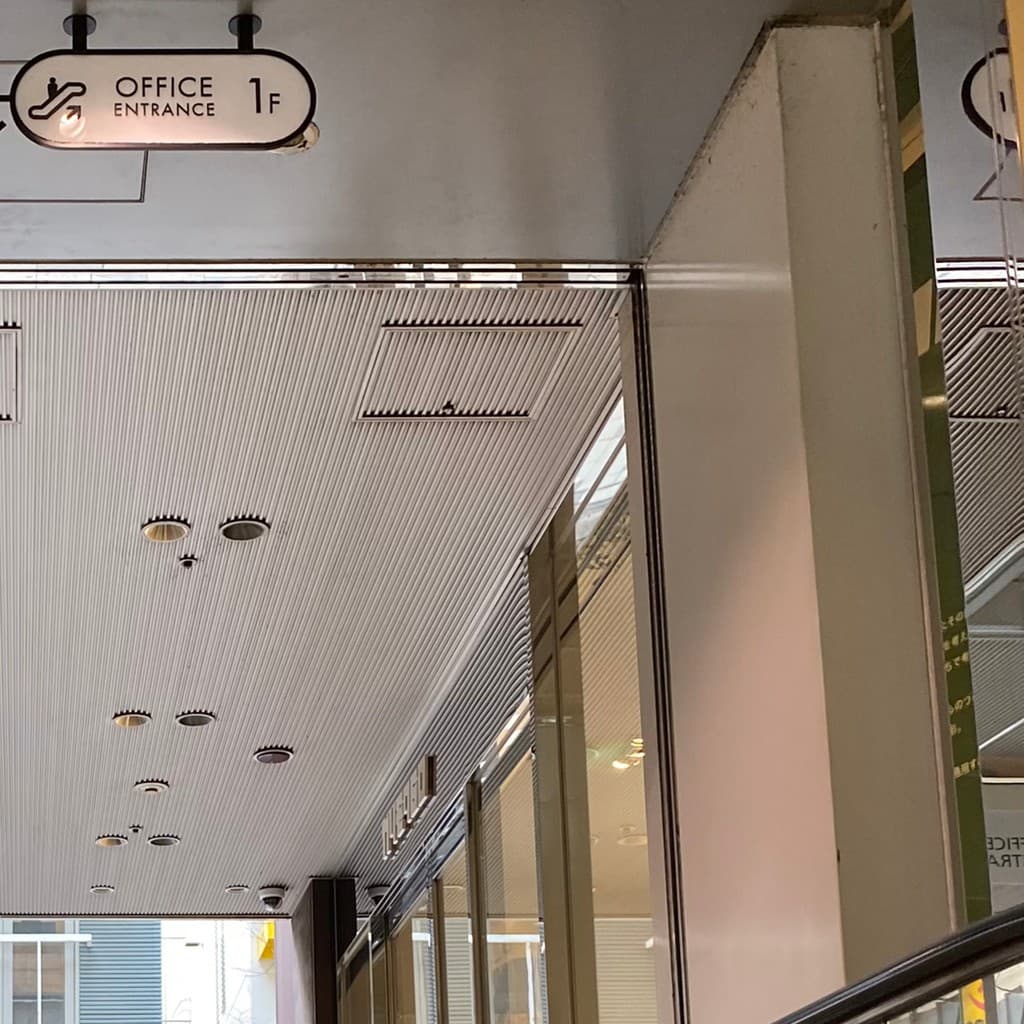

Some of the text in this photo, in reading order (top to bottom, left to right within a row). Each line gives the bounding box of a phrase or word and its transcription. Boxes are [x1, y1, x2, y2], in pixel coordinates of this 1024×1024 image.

[115, 76, 214, 98] OFFICE
[248, 77, 281, 115] 1F
[114, 102, 216, 117] ENTRANCE
